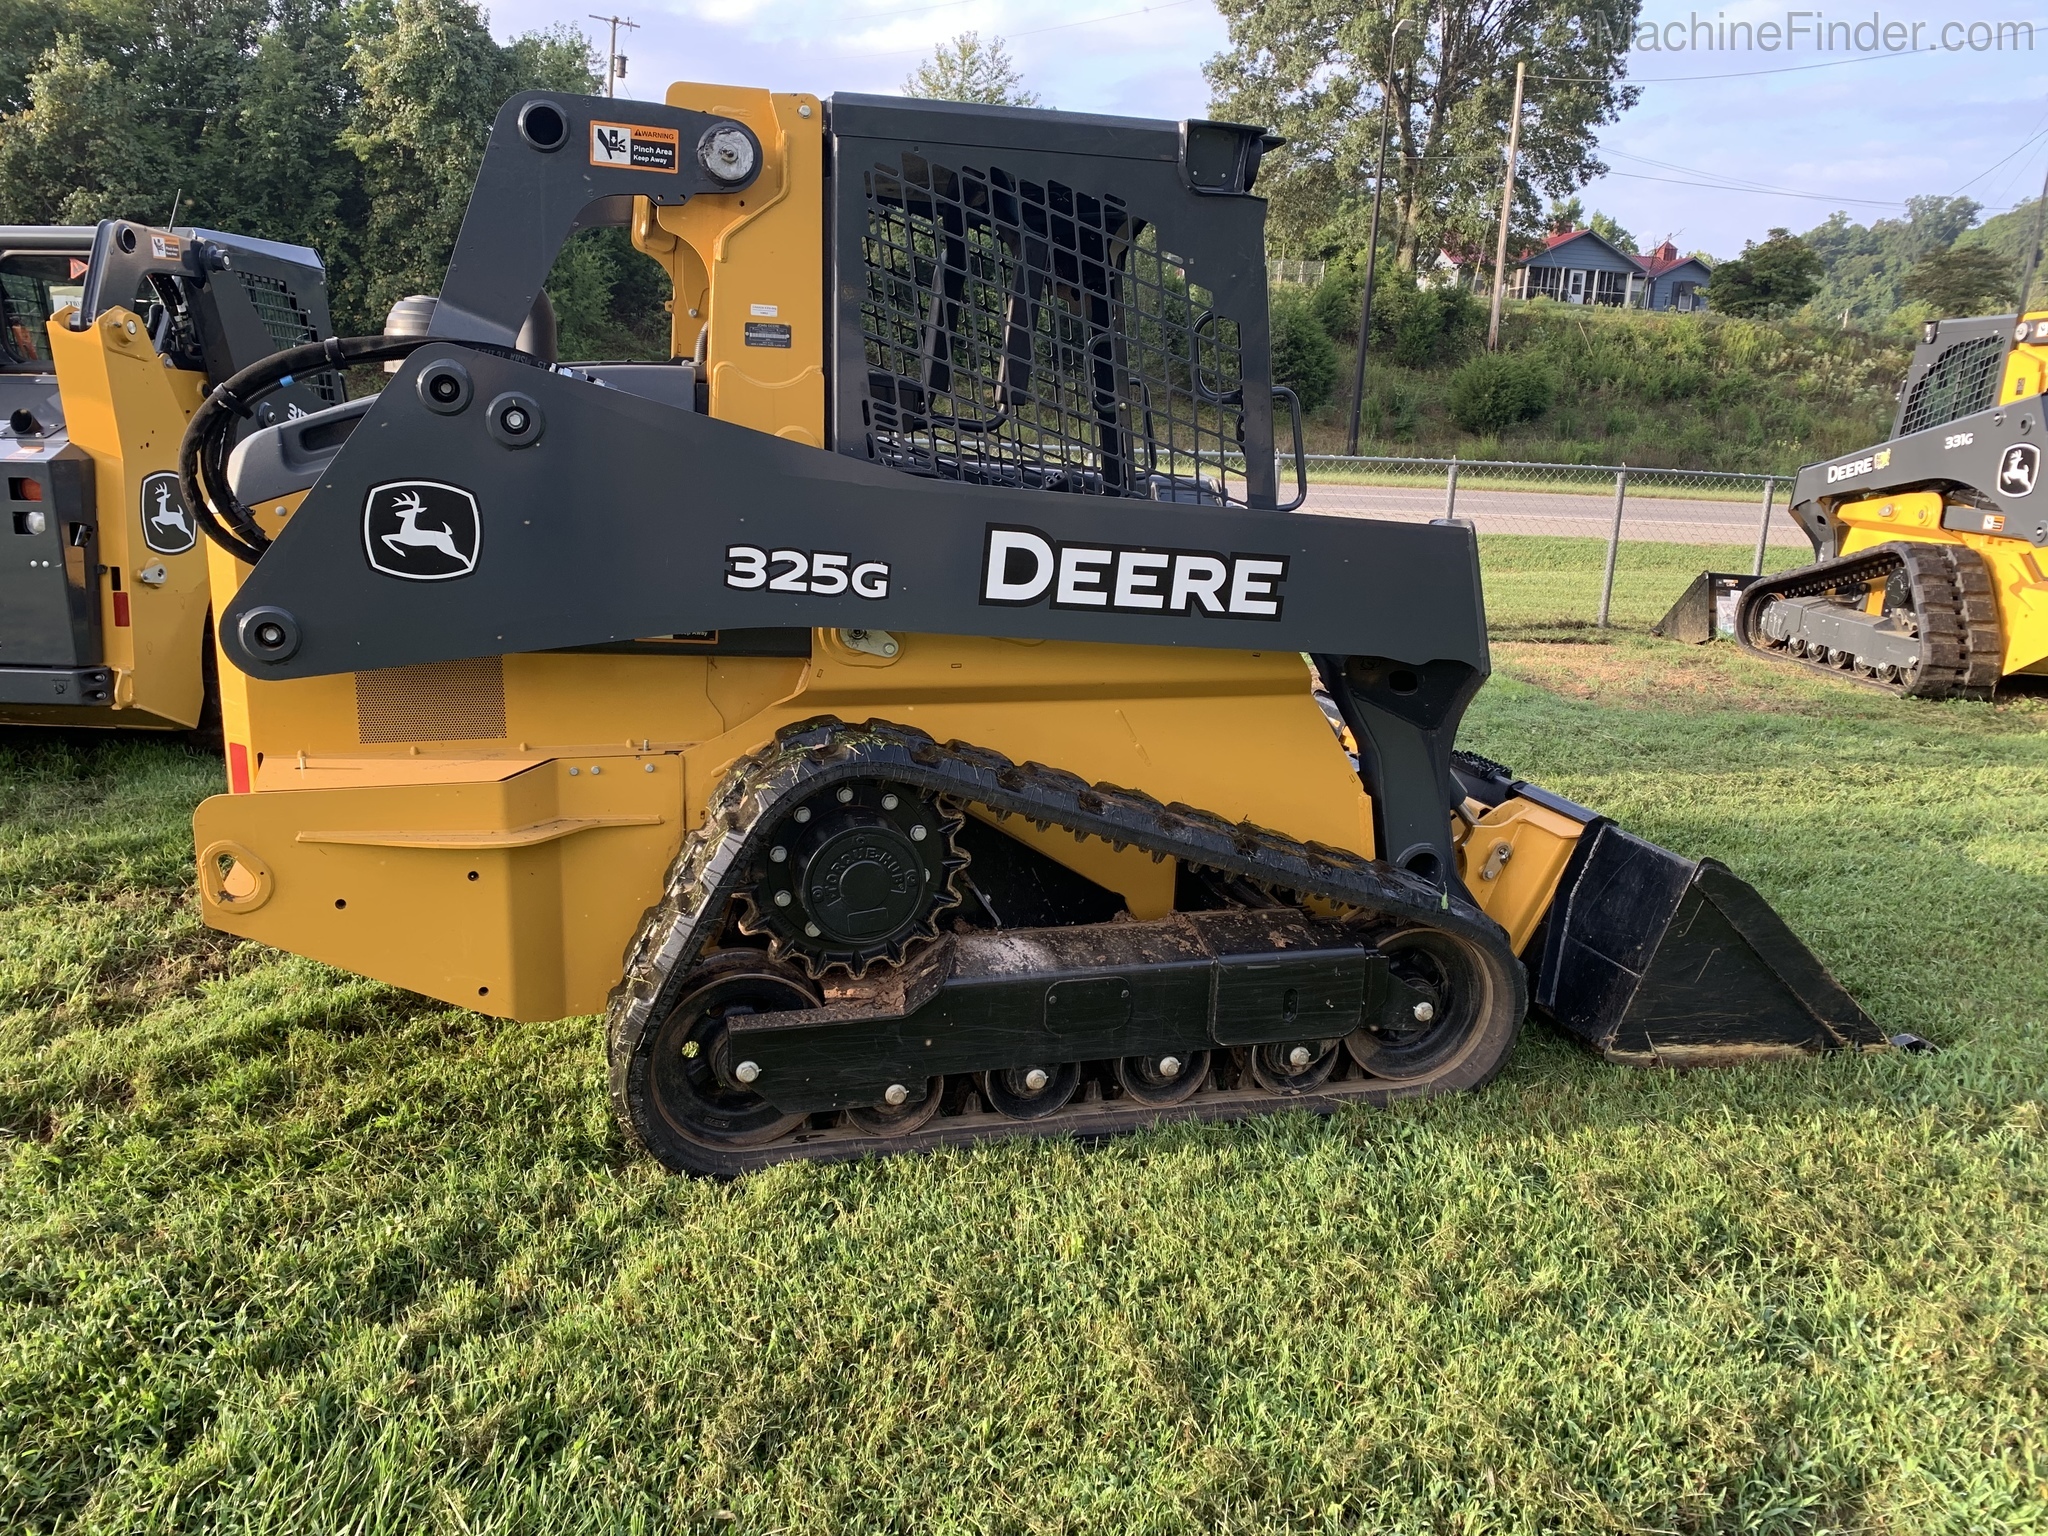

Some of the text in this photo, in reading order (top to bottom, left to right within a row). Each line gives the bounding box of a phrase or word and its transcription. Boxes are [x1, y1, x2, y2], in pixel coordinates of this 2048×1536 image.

[640, 130, 675, 140] WARNING
[633, 144, 673, 156] Pinch Area
[633, 154, 667, 164] Keep Away
[1944, 432, 1974, 450] 331G
[1827, 456, 1874, 484] DEERE
[727, 546, 889, 599] 325G
[985, 530, 1284, 615] DEERE
